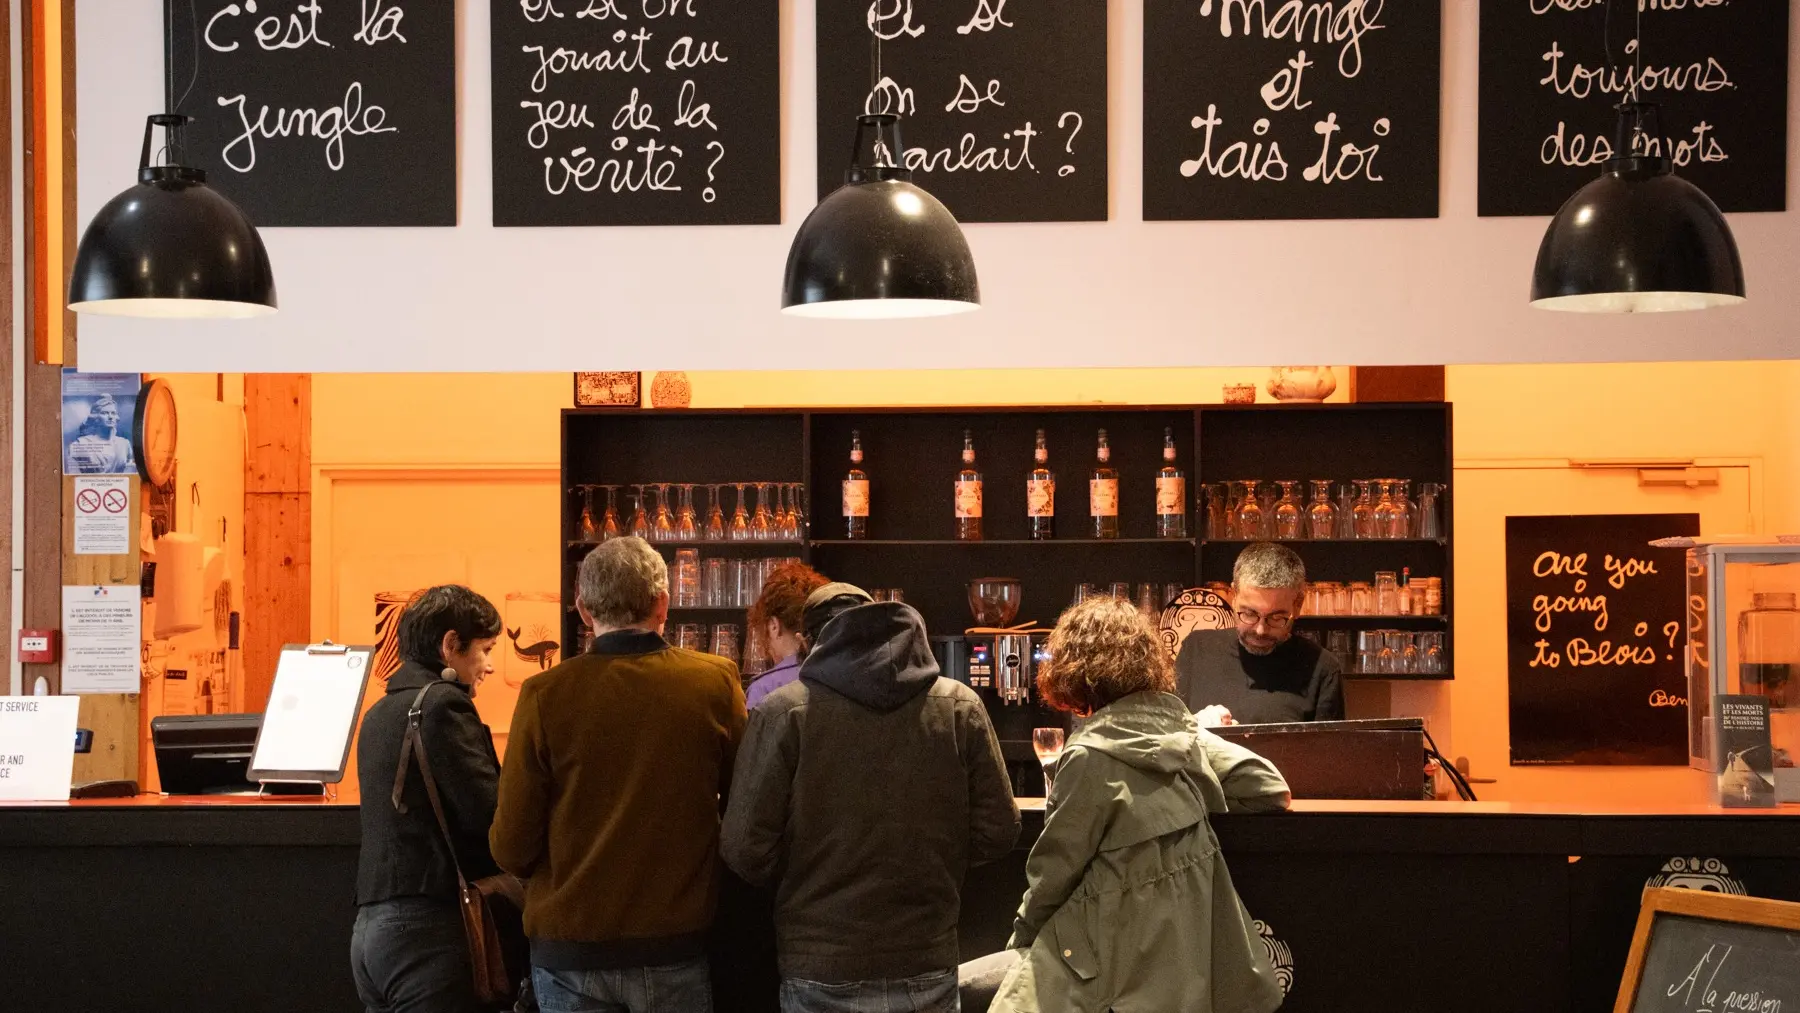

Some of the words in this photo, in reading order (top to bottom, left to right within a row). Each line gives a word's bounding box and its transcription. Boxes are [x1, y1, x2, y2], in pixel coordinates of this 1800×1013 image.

[353, 0, 407, 46] la
[522, 27, 652, 93] jouait
[665, 36, 729, 70] au
[1260, 49, 1315, 111] et
[520, 100, 595, 149] jeu
[612, 87, 661, 132] de
[674, 79, 718, 131] la
[945, 74, 1006, 113] se
[1057, 111, 1084, 177] ?
[1179, 103, 1289, 182] tais
[1302, 112, 1391, 185] toi
[1540, 121, 1615, 167] des
[702, 140, 725, 203] ?
[1604, 554, 1658, 590] you
[1532, 578, 1609, 633] going
[1529, 638, 1561, 668] to
[1566, 621, 1657, 668] Blois
[1663, 621, 1680, 662] ?
[5, 701, 39, 712] SERVICE
[7, 755, 24, 765] AND
